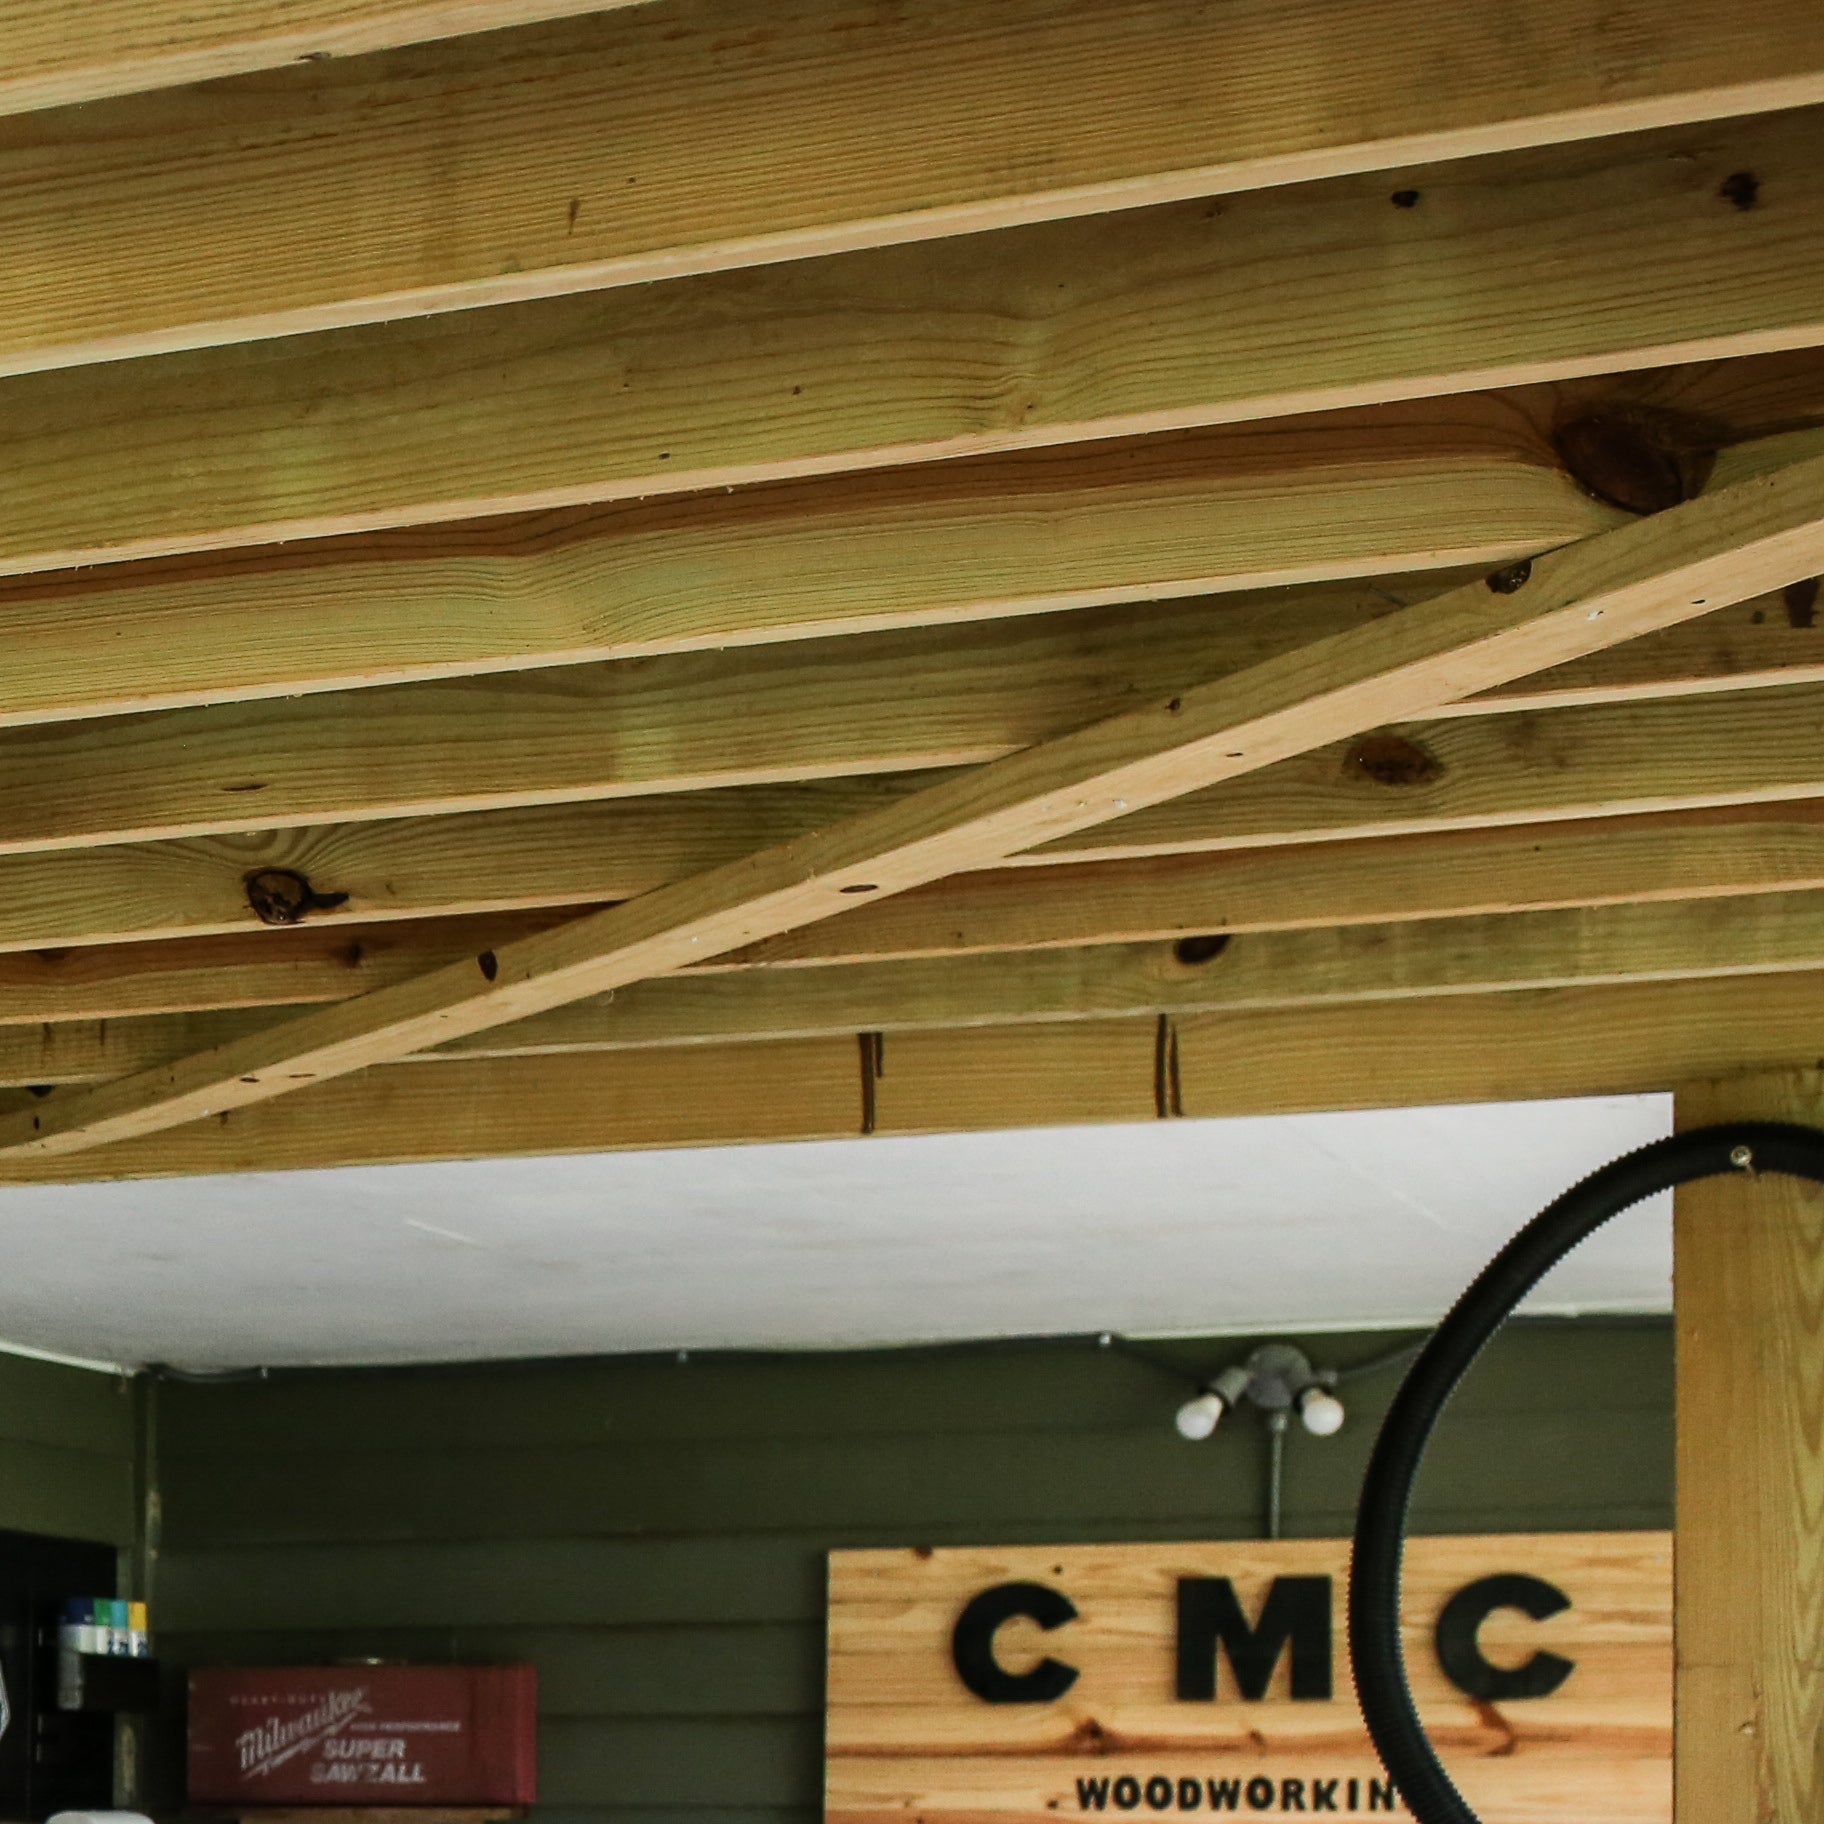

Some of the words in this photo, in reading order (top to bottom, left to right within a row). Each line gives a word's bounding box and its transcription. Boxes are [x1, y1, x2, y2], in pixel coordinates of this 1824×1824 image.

[321, 1737, 407, 1760] SUPER
[308, 1762, 427, 1784] SAWZALL
[1075, 1776, 1394, 1812] WOODWORKIN
